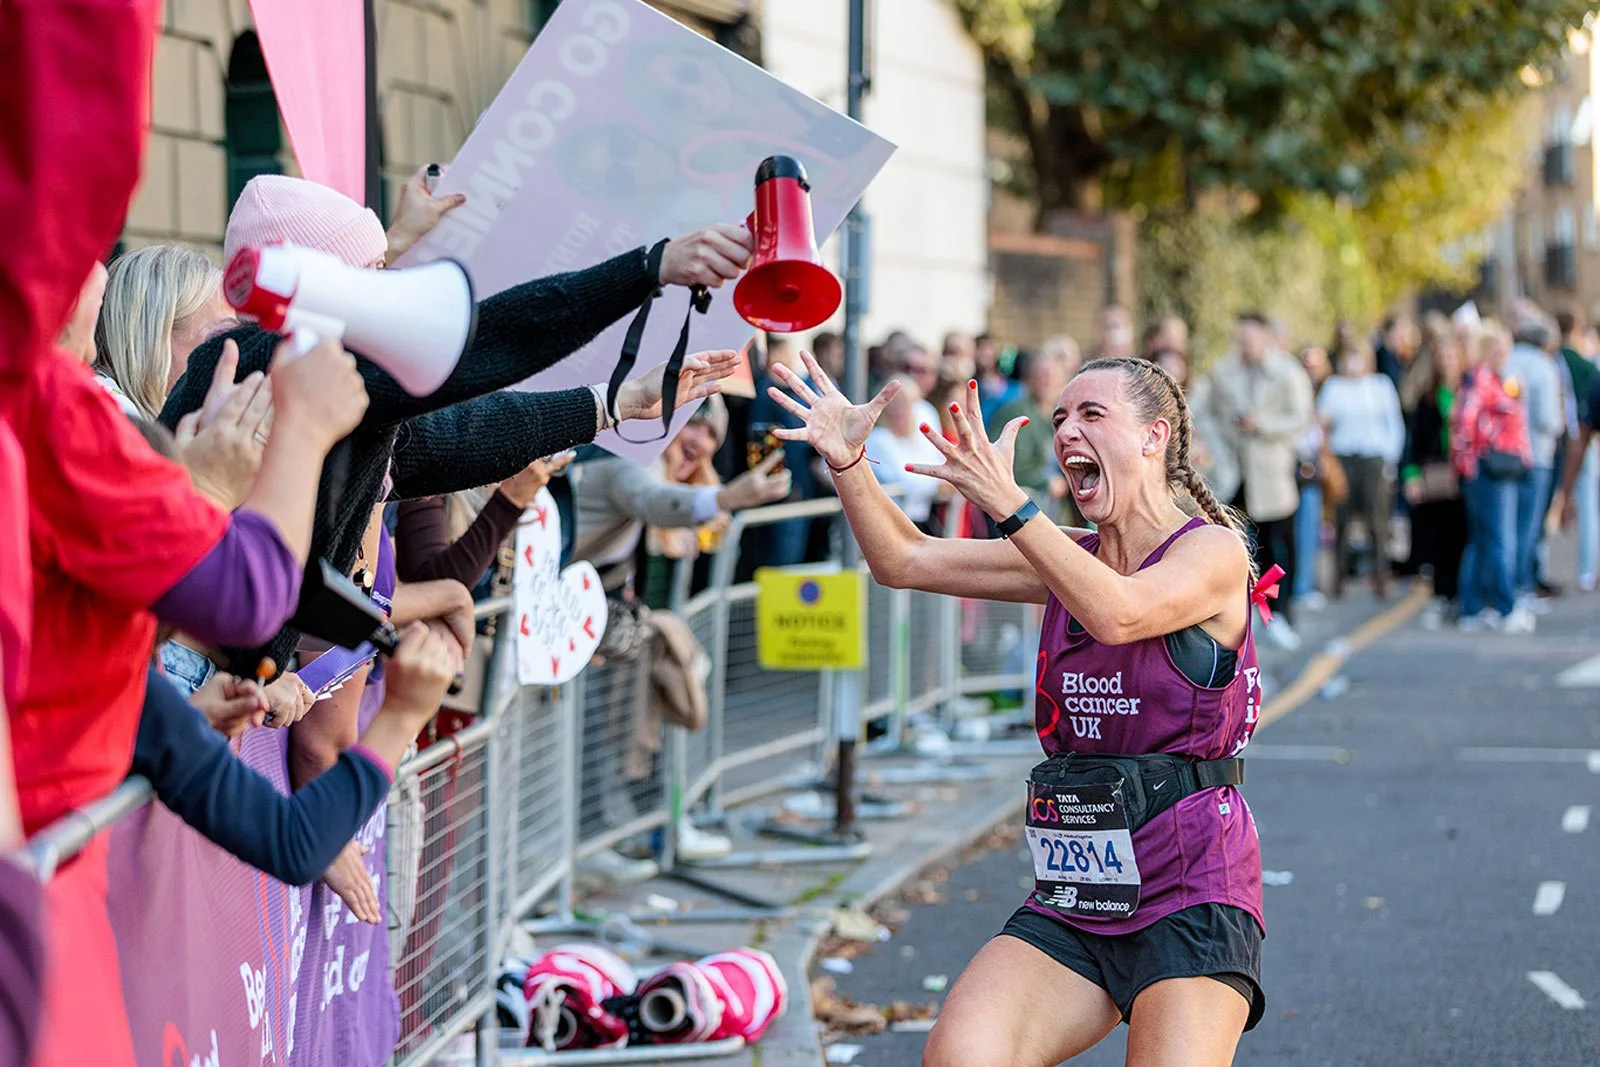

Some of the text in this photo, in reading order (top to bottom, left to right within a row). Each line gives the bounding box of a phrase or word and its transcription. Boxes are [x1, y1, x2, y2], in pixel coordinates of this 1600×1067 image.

[1061, 671, 1123, 694] Blood
[1064, 696, 1141, 715] cancer
[1069, 715, 1102, 740] UK
[1055, 794, 1080, 804] TATA
[1058, 803, 1115, 814] CONSULTANCY
[1061, 814, 1097, 825] SERVICES
[1040, 837, 1123, 874] 22814
[1078, 899, 1130, 912] new balance
